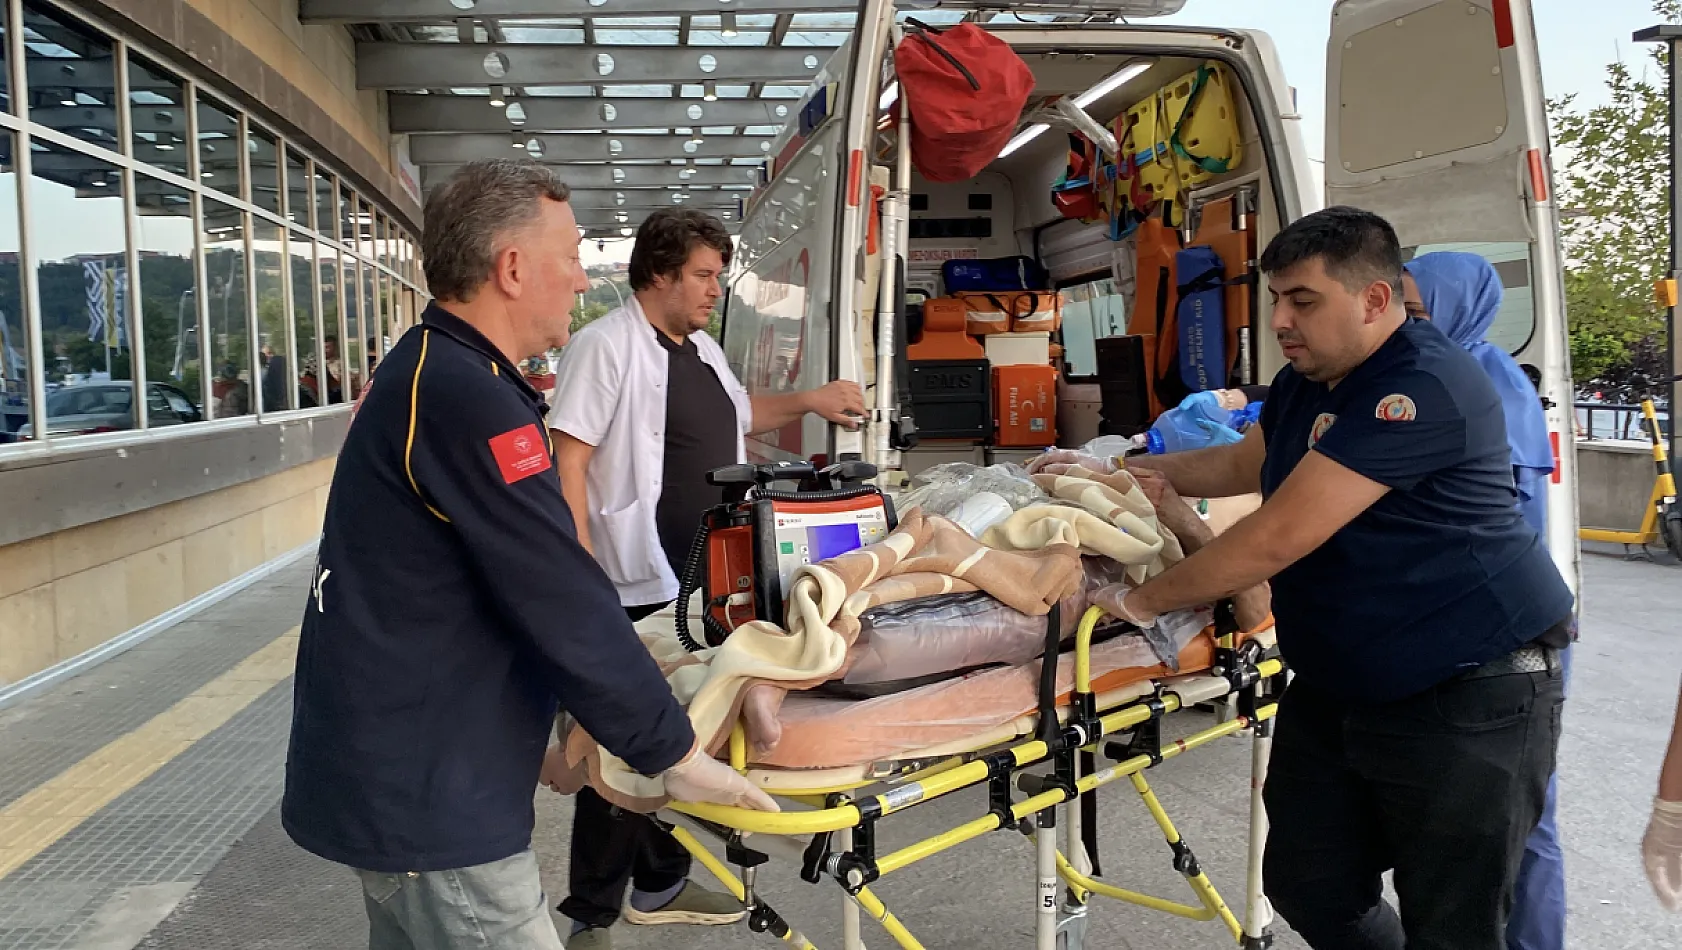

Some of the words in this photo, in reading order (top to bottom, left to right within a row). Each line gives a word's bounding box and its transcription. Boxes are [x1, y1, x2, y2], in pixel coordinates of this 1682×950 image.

[925, 372, 973, 390] EMS
[1009, 387, 1019, 408] First
[1009, 410, 1019, 426] Aid
